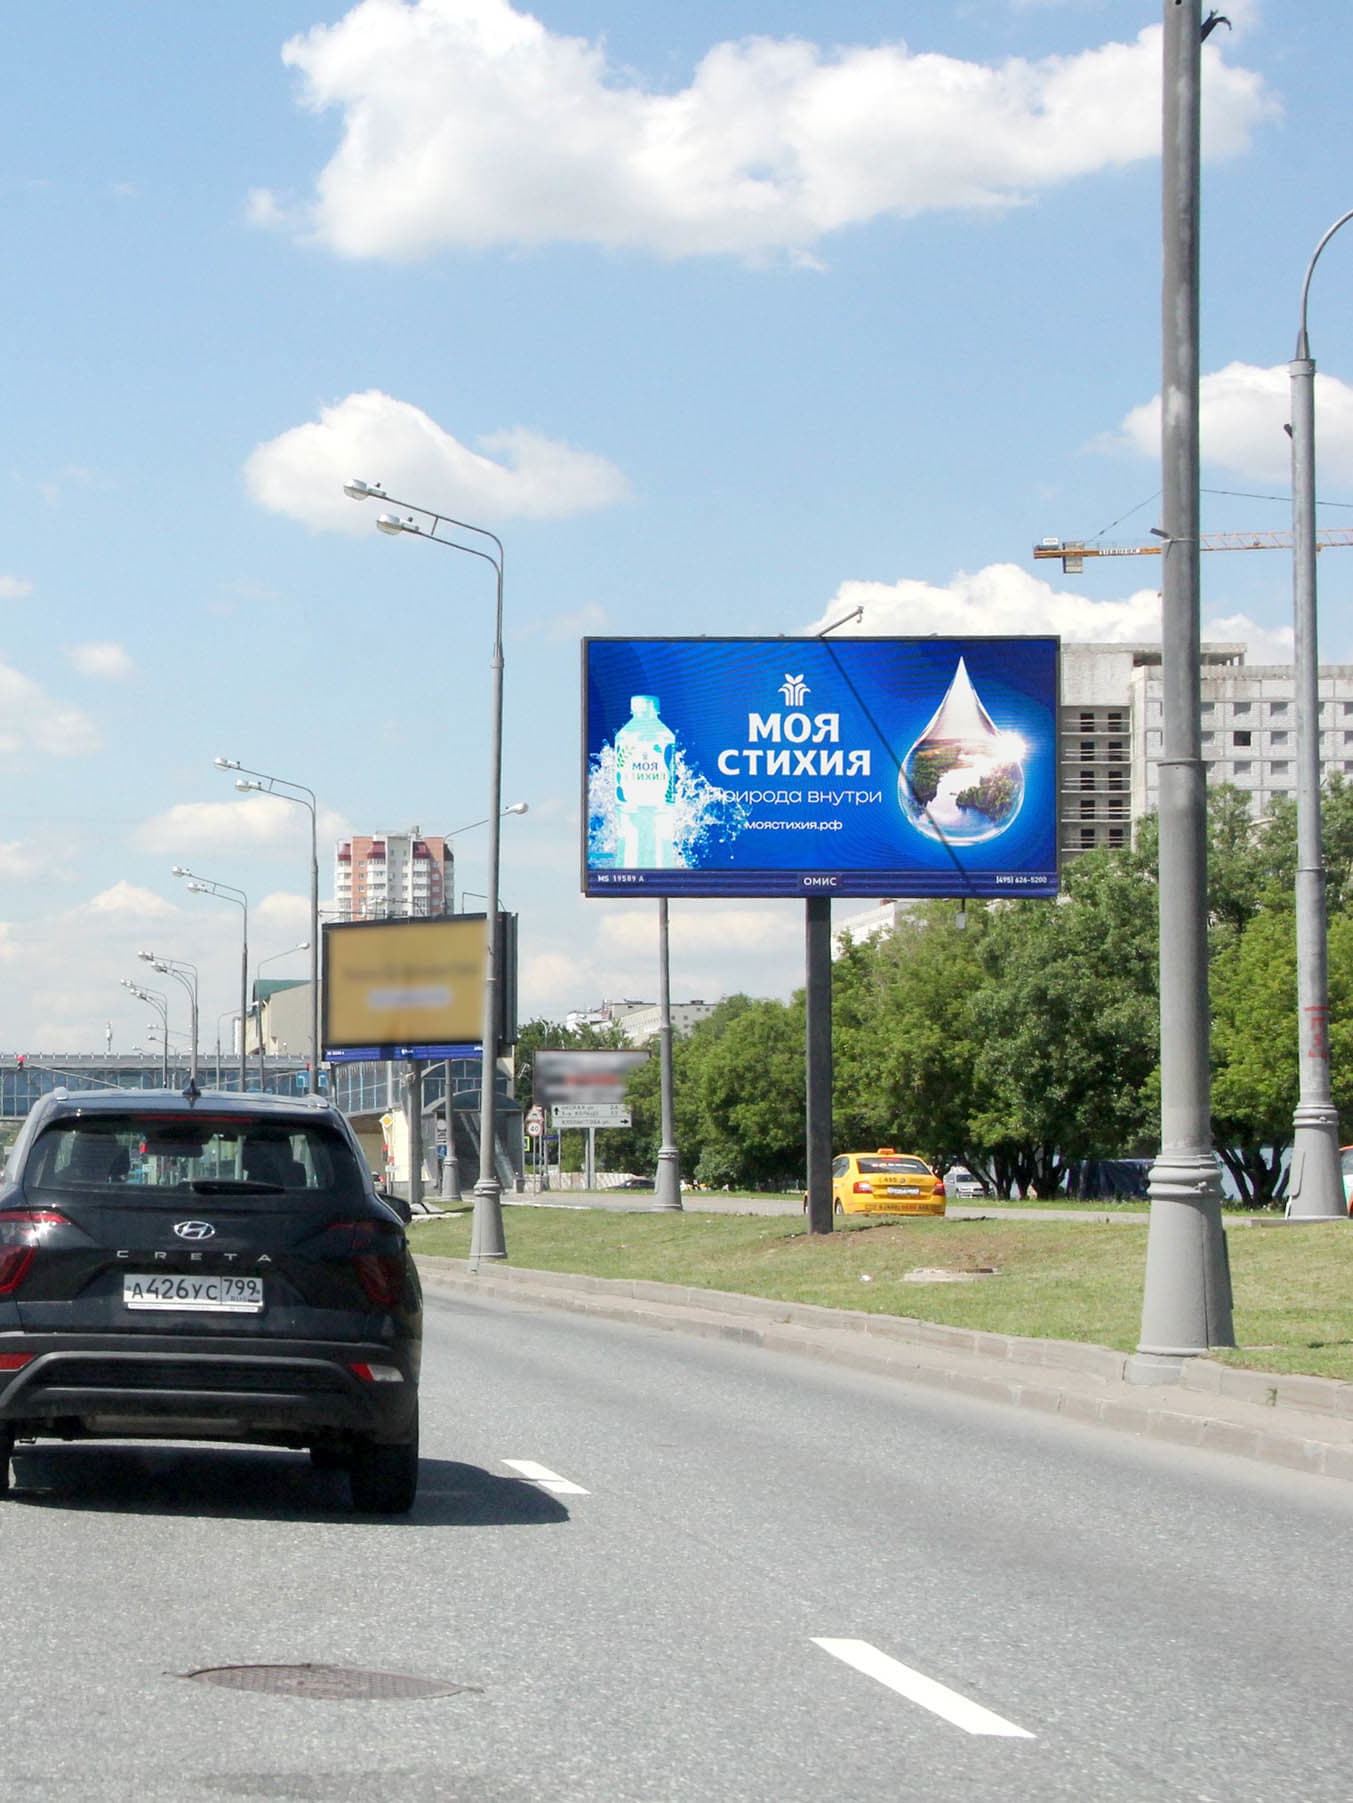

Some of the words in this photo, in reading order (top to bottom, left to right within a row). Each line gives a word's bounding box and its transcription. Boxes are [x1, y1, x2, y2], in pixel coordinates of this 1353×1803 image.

[749, 713, 840, 743] МОЯ
[632, 761, 658, 771] МОЯ
[717, 749, 871, 776] СТИХИЯ
[807, 790, 883, 806] внутри
[744, 819, 844, 832] моястихия.рф
[803, 876, 837, 886] ОМИС
[116, 1250, 272, 1262] CRETA
[223, 1278, 257, 1296] 799
